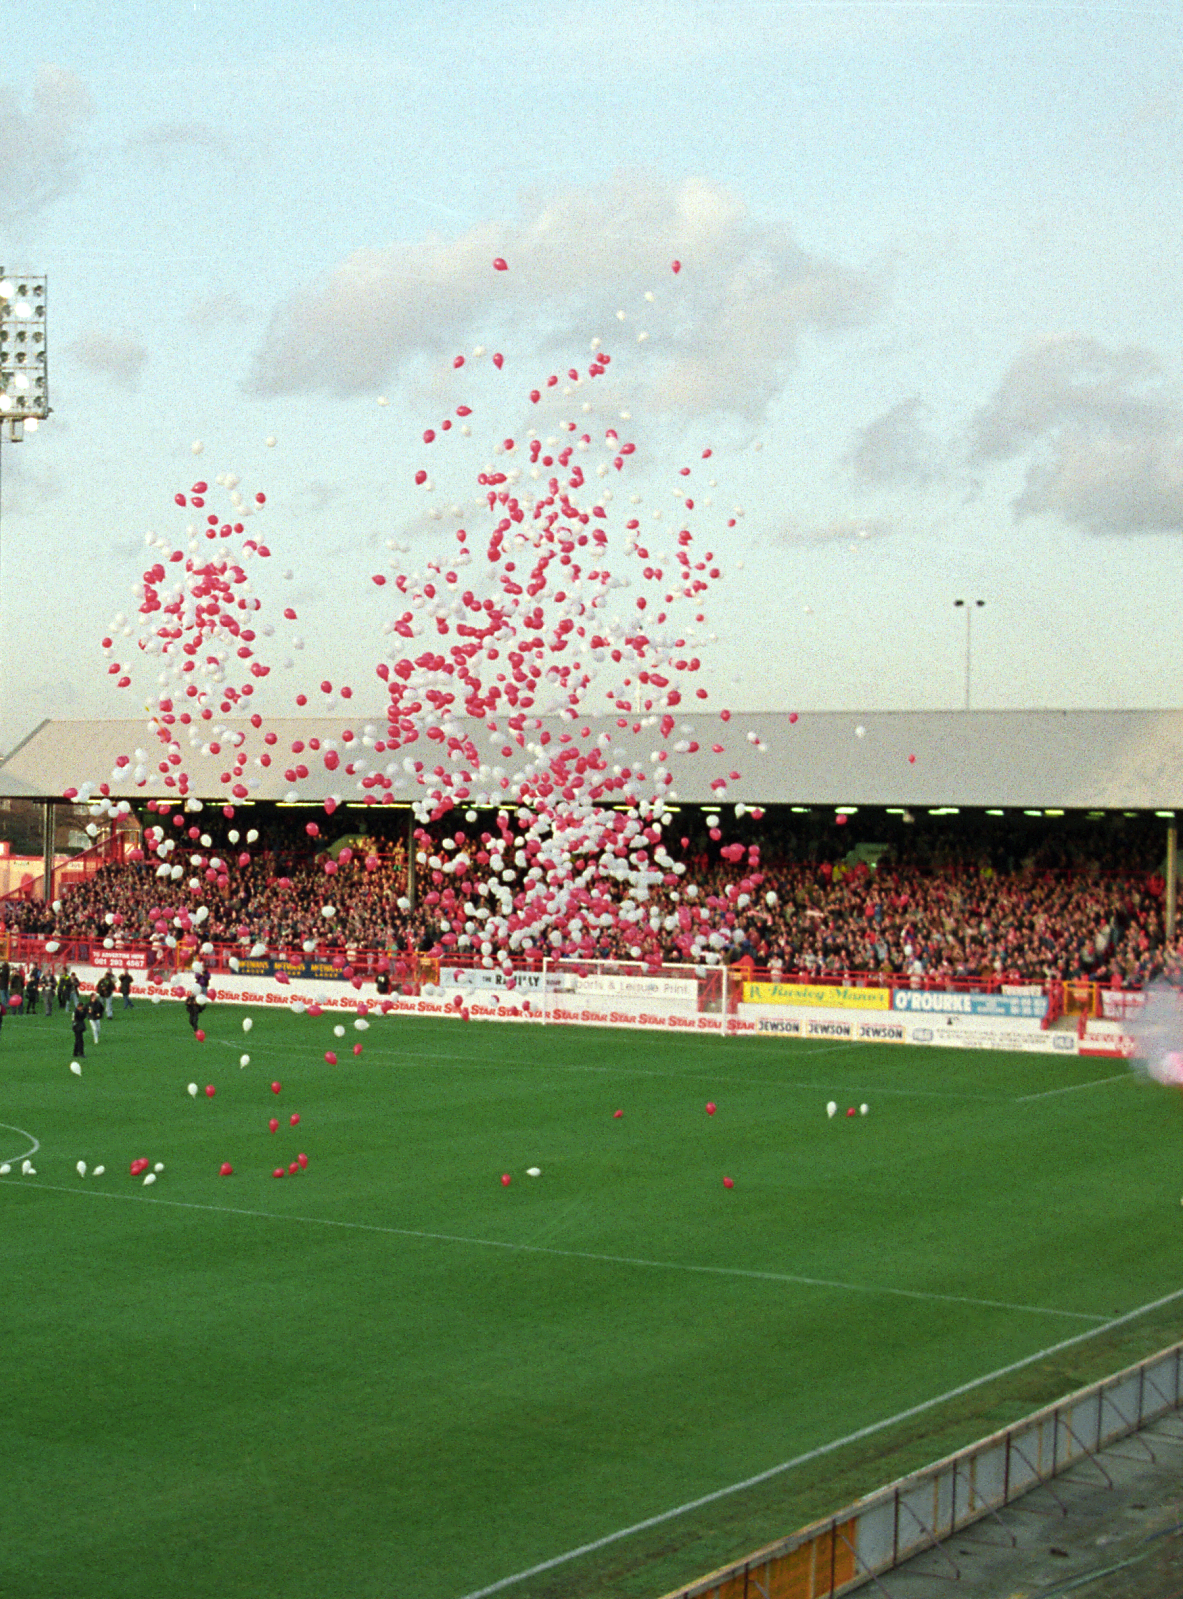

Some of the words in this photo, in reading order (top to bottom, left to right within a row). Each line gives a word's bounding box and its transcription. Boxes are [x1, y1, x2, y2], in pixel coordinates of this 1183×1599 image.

[217, 990, 240, 1001] STAR
[242, 991, 264, 1002] STAR
[266, 993, 288, 1004] STAR
[417, 1001, 442, 1012] STAR
[471, 1005, 496, 1015] STAR
[553, 1008, 579, 1019] STAR
[581, 1010, 608, 1021] STAR
[610, 1011, 636, 1023] STAR
[638, 1013, 666, 1024] STAR
[668, 1015, 696, 1026] STAR
[727, 1018, 755, 1030] STAR
[895, 991, 972, 1012] O'ROURKE
[759, 1020, 800, 1032] JEWSON
[808, 1023, 850, 1036] JEWSON
[860, 1026, 903, 1039] JEWSON
